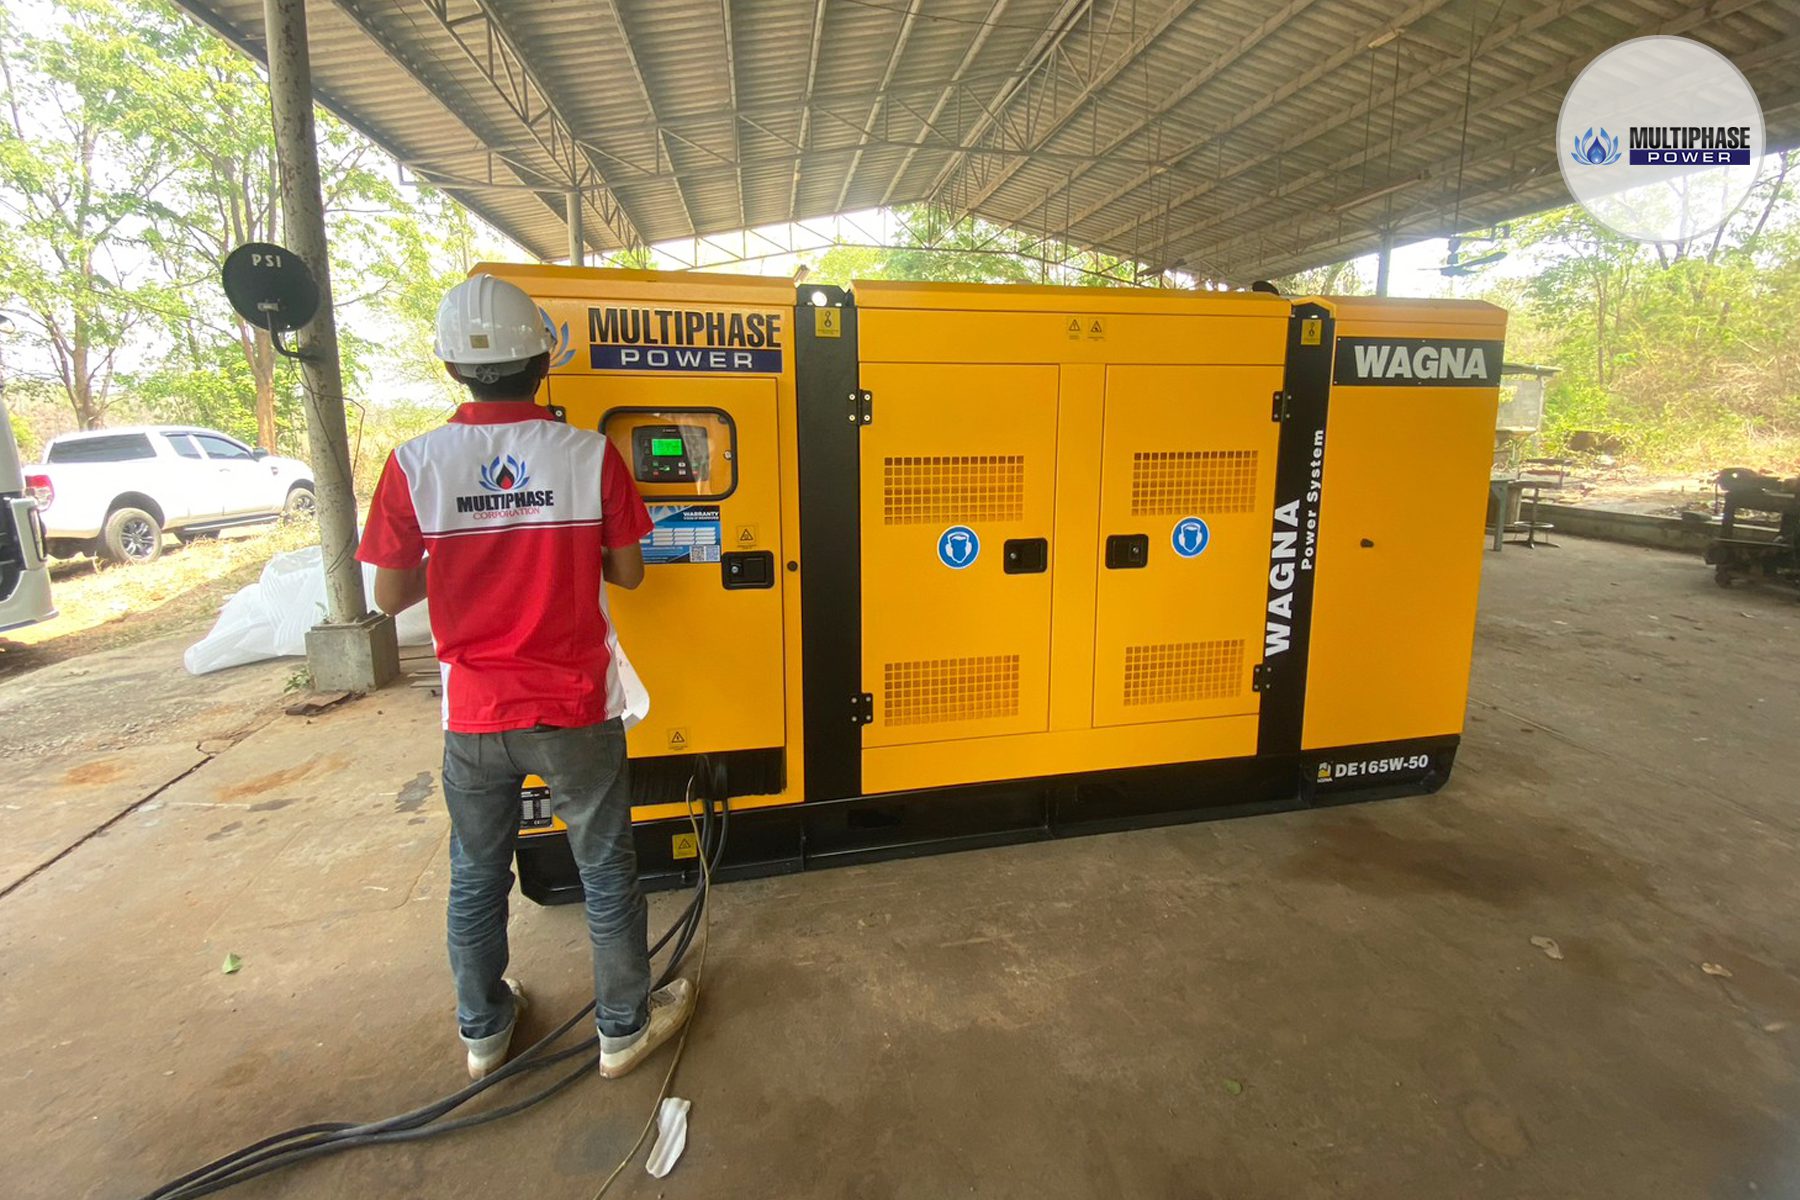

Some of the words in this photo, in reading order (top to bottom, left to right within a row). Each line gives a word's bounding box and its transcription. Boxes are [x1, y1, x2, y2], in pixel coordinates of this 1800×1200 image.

[251, 253, 281, 268] PSI
[588, 307, 781, 348] MULTIPHASE
[621, 349, 753, 368] POWER
[1354, 345, 1487, 379] WAGNA
[1306, 429, 1324, 502] System
[456, 490, 554, 513] MULTIPHASE
[473, 507, 541, 520] CORPORATION
[1301, 509, 1317, 570] Power
[1265, 499, 1300, 657] WAGNA
[1335, 754, 1429, 778] DE165W-50
